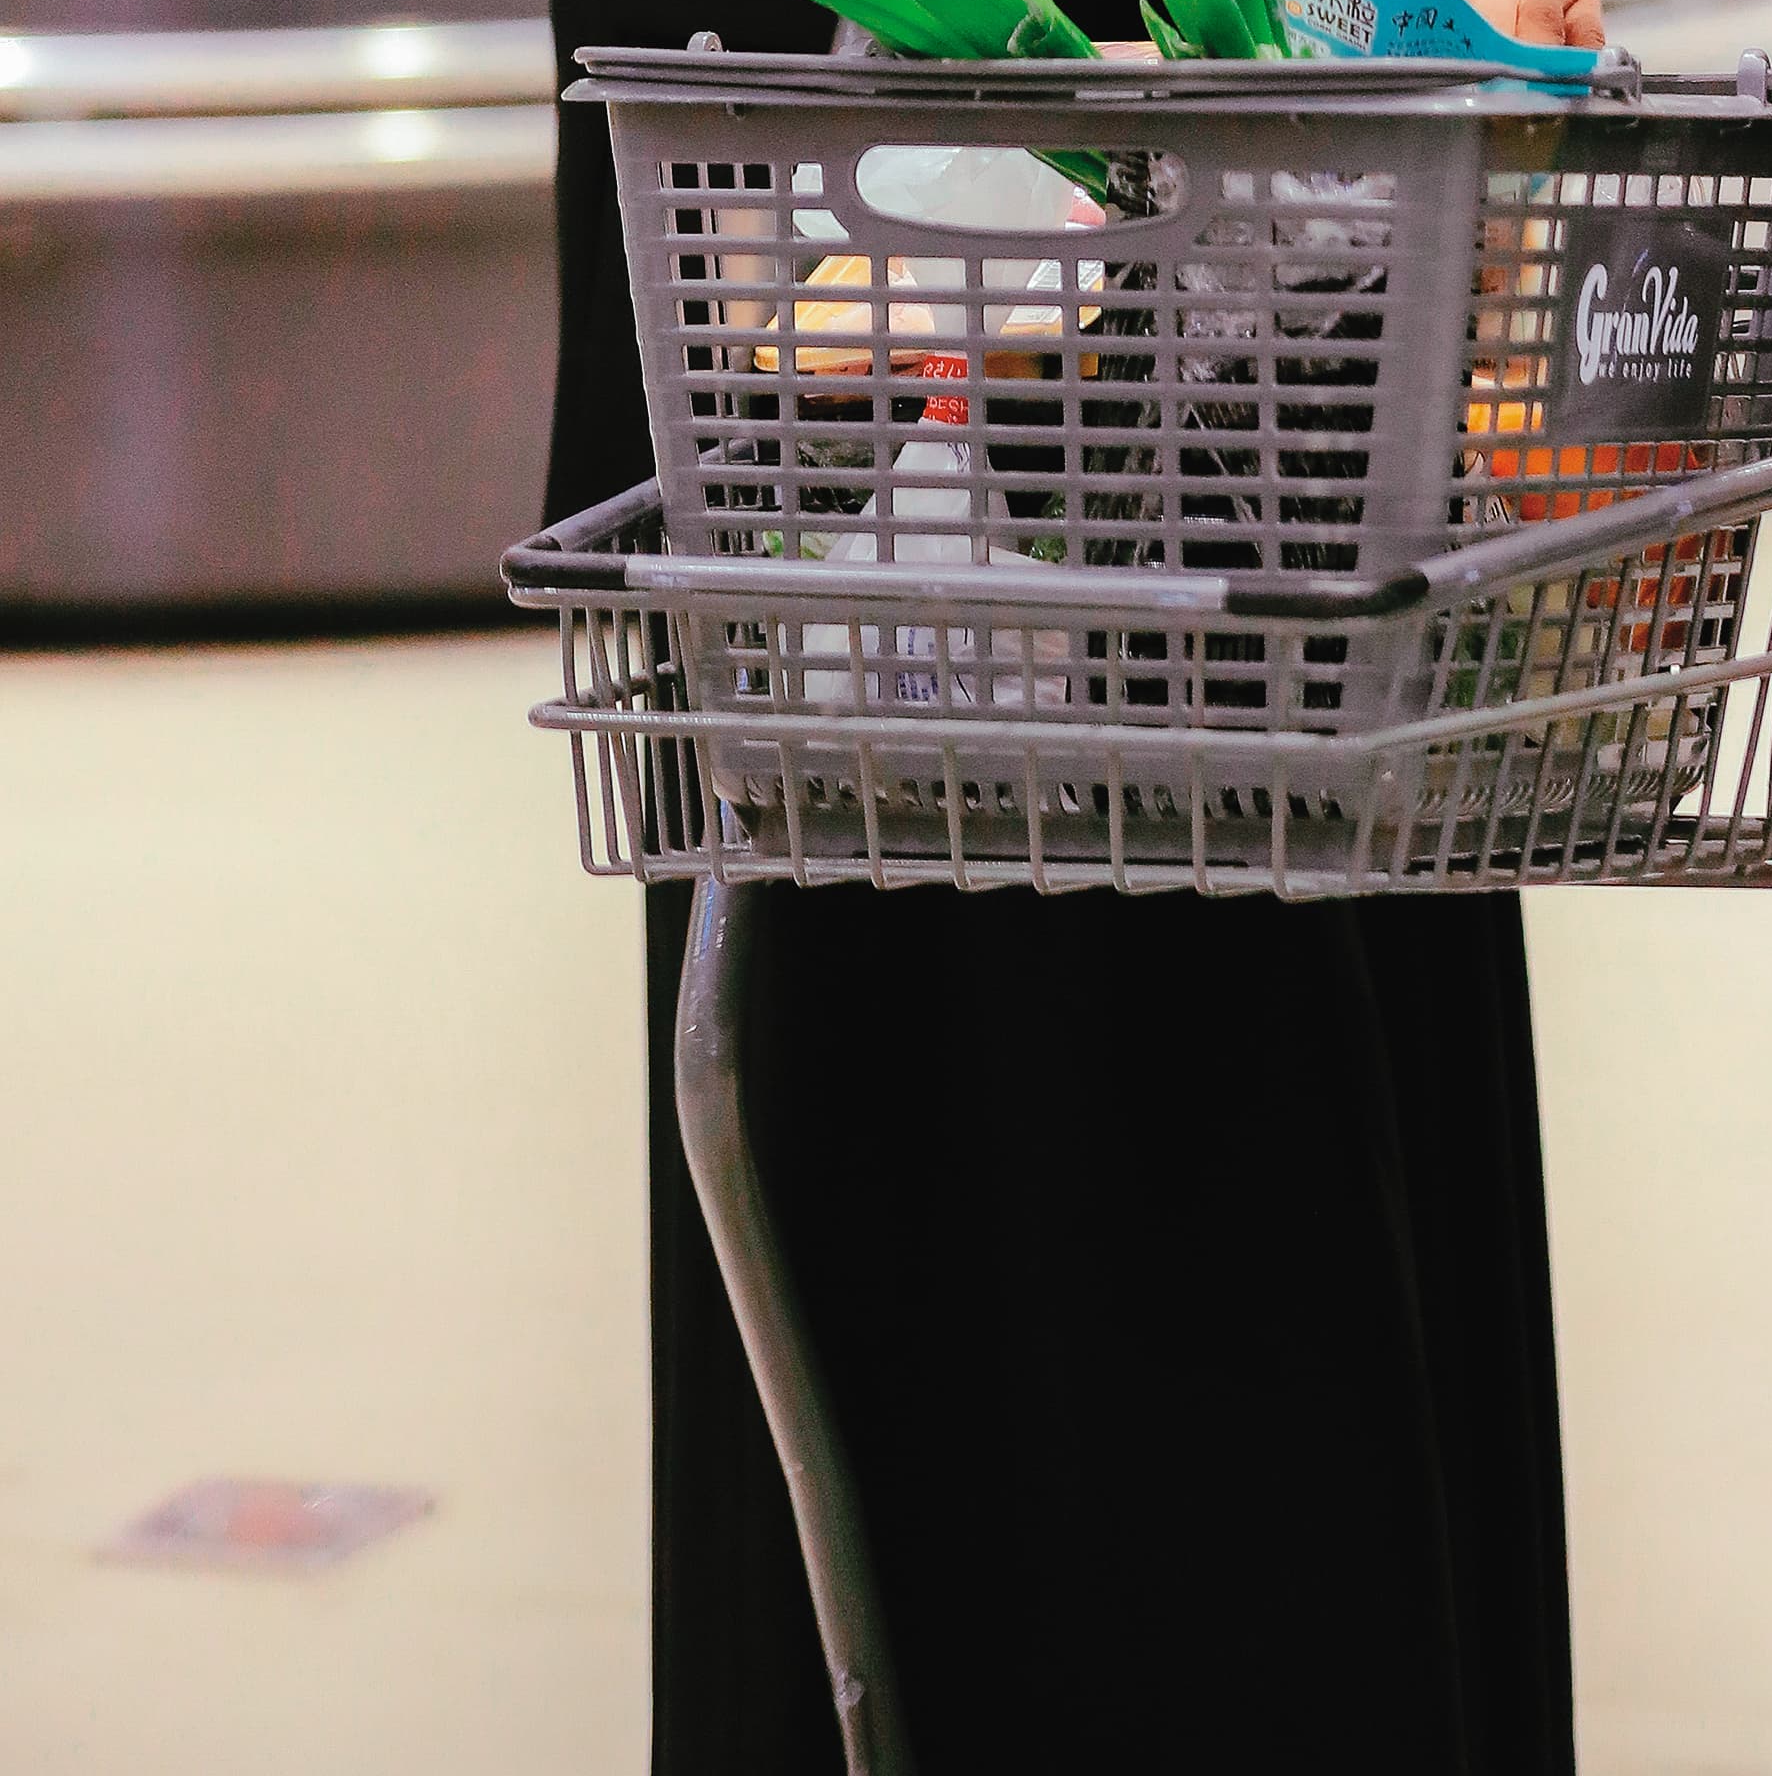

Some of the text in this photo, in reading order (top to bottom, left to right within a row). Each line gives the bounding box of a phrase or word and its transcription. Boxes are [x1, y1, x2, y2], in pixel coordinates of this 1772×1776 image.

[1307, 3, 1373, 44] SWEET
[1576, 263, 1698, 385] GranVida
[1623, 358, 1660, 382] enjoy
[1668, 358, 1692, 378] life
